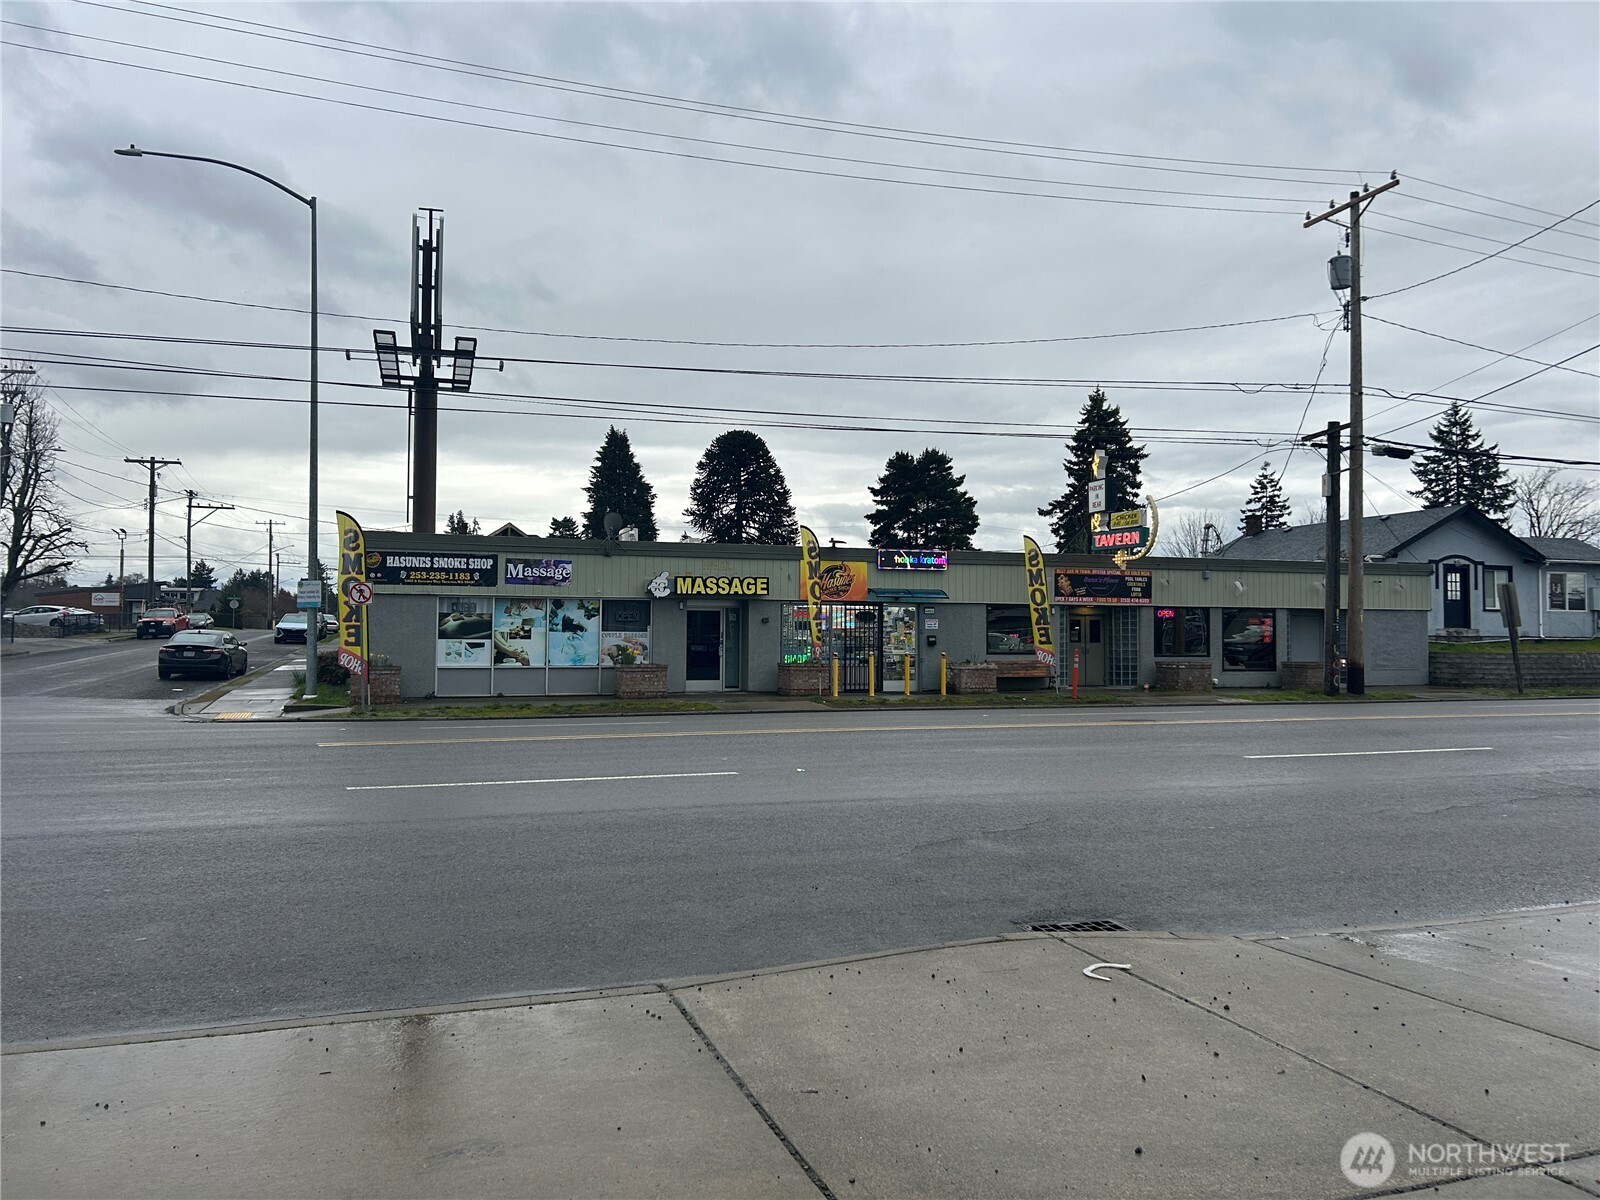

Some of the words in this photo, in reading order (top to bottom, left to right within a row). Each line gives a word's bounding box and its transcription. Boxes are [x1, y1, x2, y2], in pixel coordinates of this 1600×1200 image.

[1093, 531, 1140, 547] TAVERN
[386, 555, 431, 568] HASUNES
[433, 557, 467, 569] SMOKE
[468, 558, 494, 569] SHOP
[409, 571, 471, 580] 253-235-1183
[506, 563, 571, 580] Massage
[676, 577, 768, 595] MASSAGE
[1157, 610, 1174, 618] OPEN
